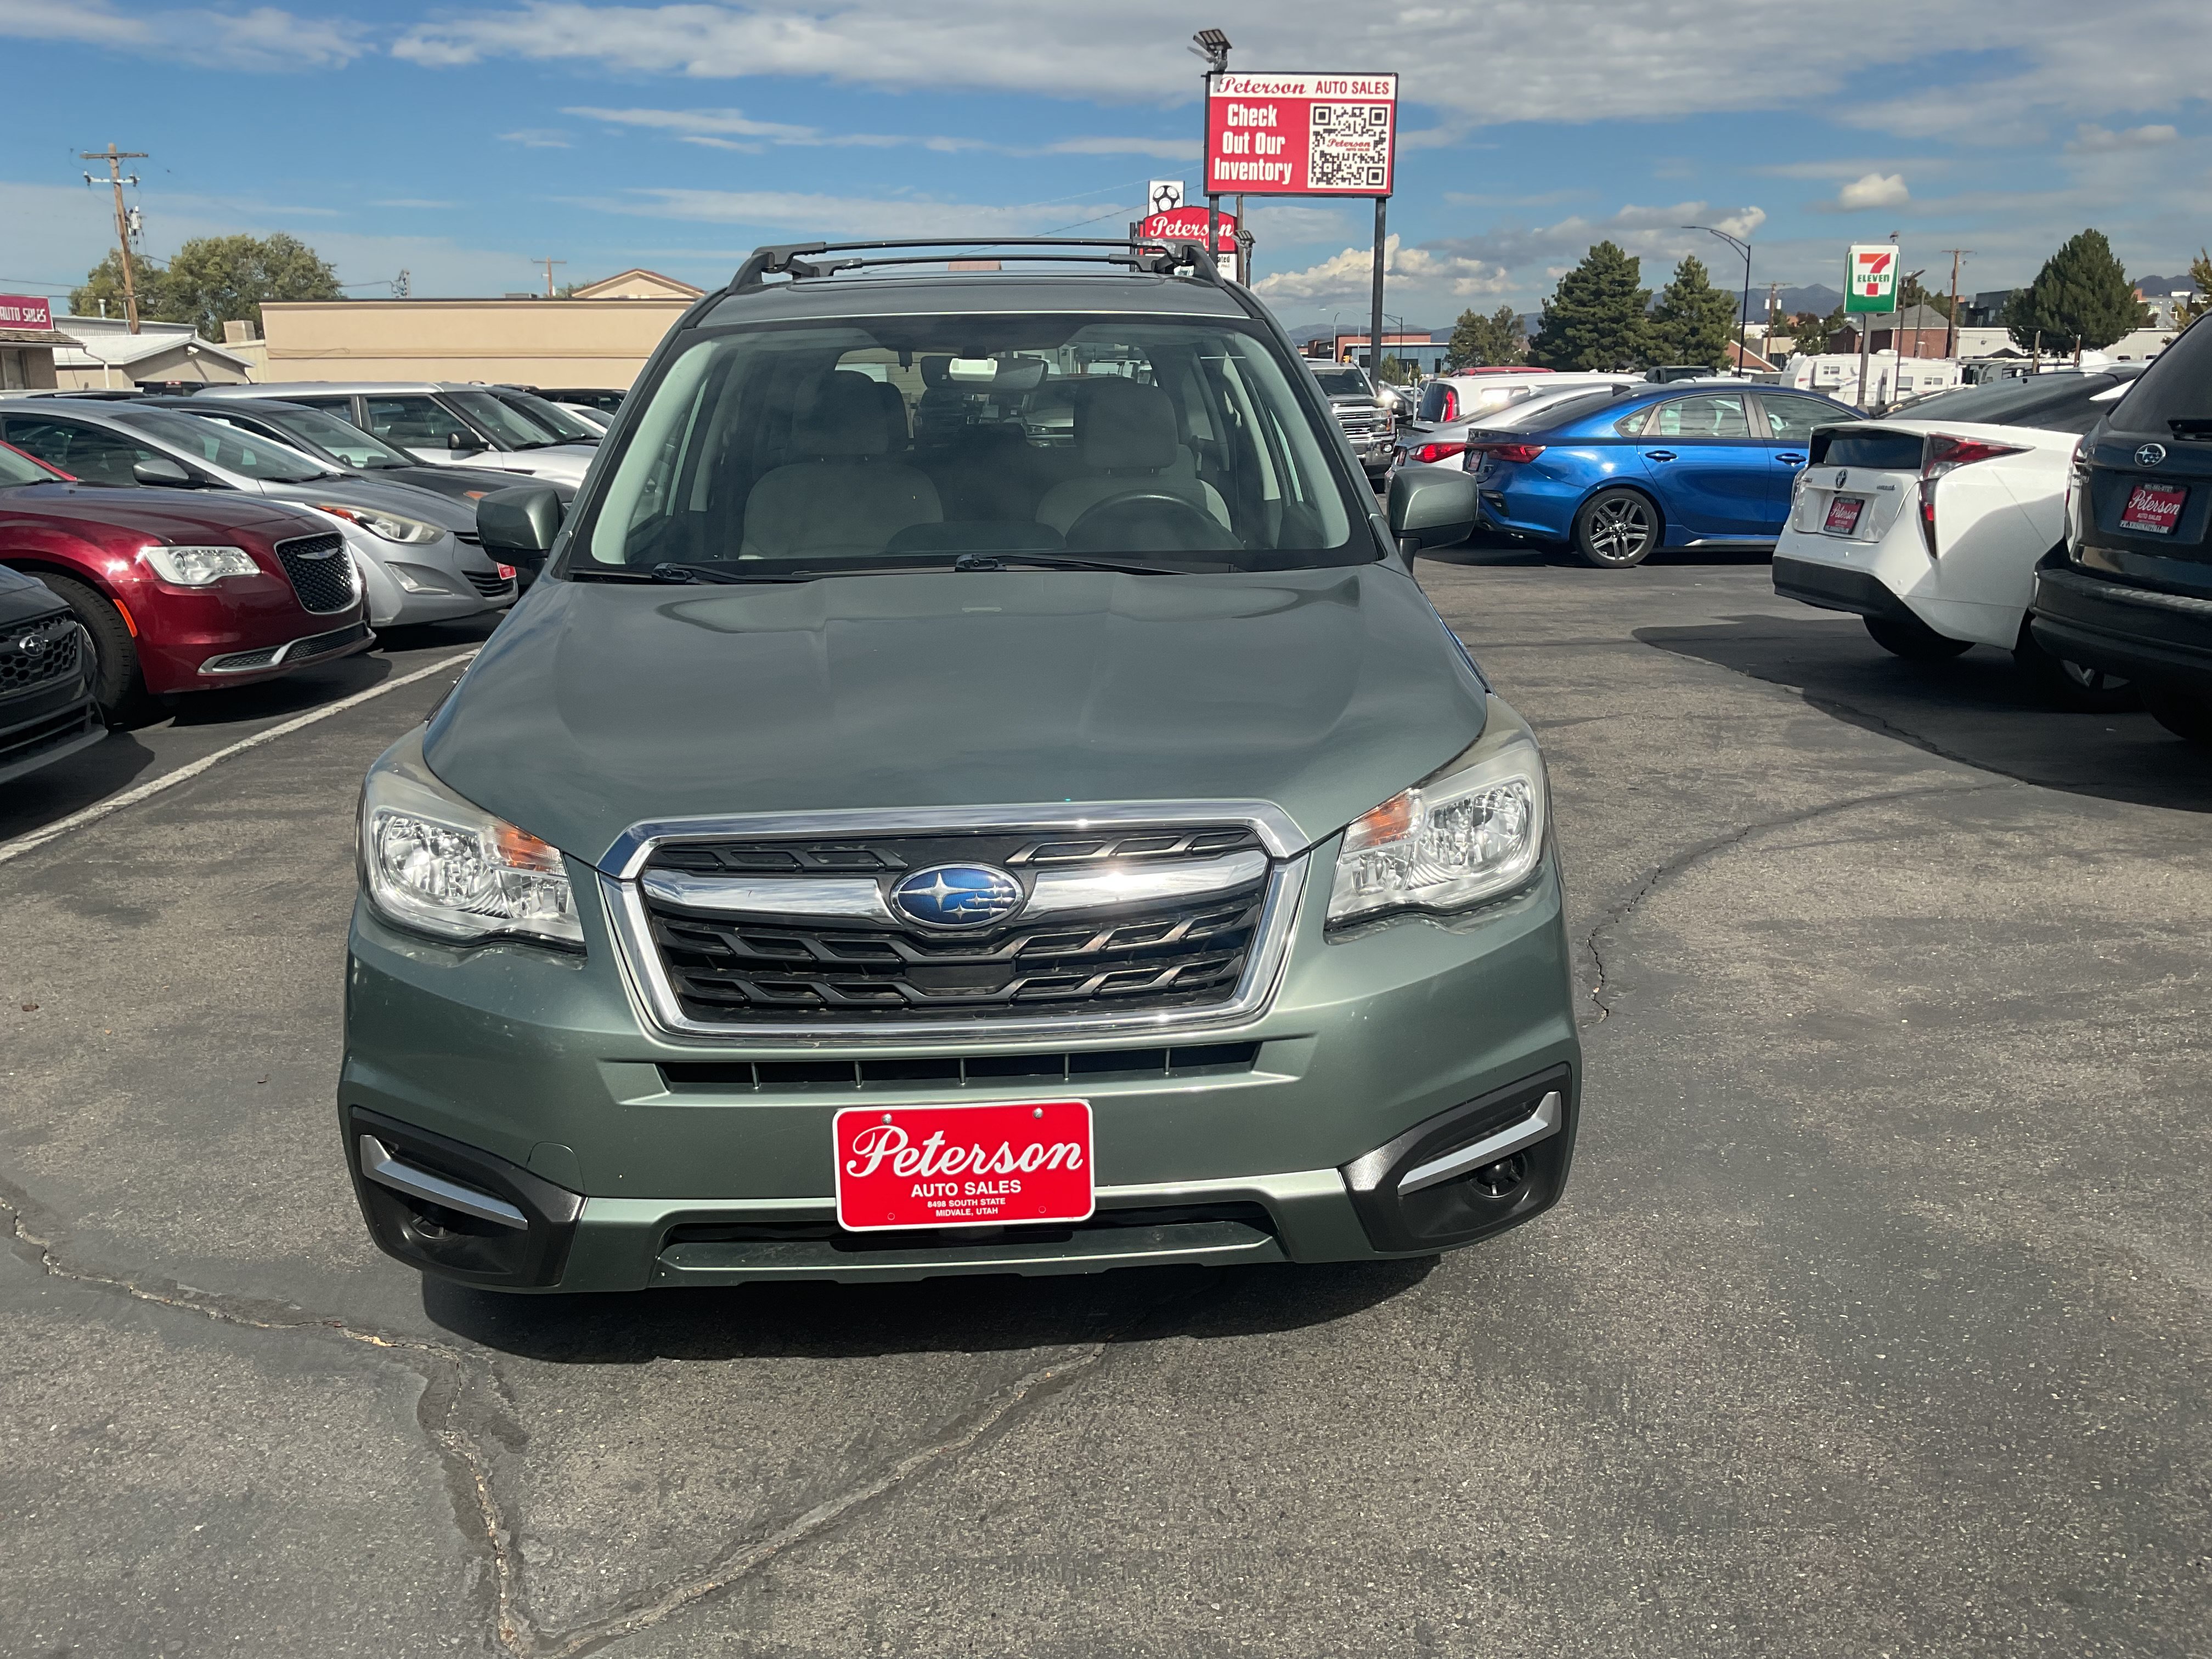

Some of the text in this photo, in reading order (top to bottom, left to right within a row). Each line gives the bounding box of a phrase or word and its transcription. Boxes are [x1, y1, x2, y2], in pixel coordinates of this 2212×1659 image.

[1217, 76, 1389, 94] Peterson AUTO SALES
[1228, 103, 1277, 127] Check
[1222, 131, 1285, 155] Out Our
[1327, 138, 1371, 147] Peterson
[1214, 157, 1293, 185] Inventory
[1150, 216, 1233, 236] Petersn
[0, 306, 47, 322] AUTO SALES
[2128, 489, 2180, 515] Peterson
[847, 1125, 1084, 1178] Peterson
[911, 1180, 1022, 1198] AUTO SALES
[935, 1207, 998, 1217] MIDVALE, UTAH
[949, 1199, 978, 1207] SOUTH
